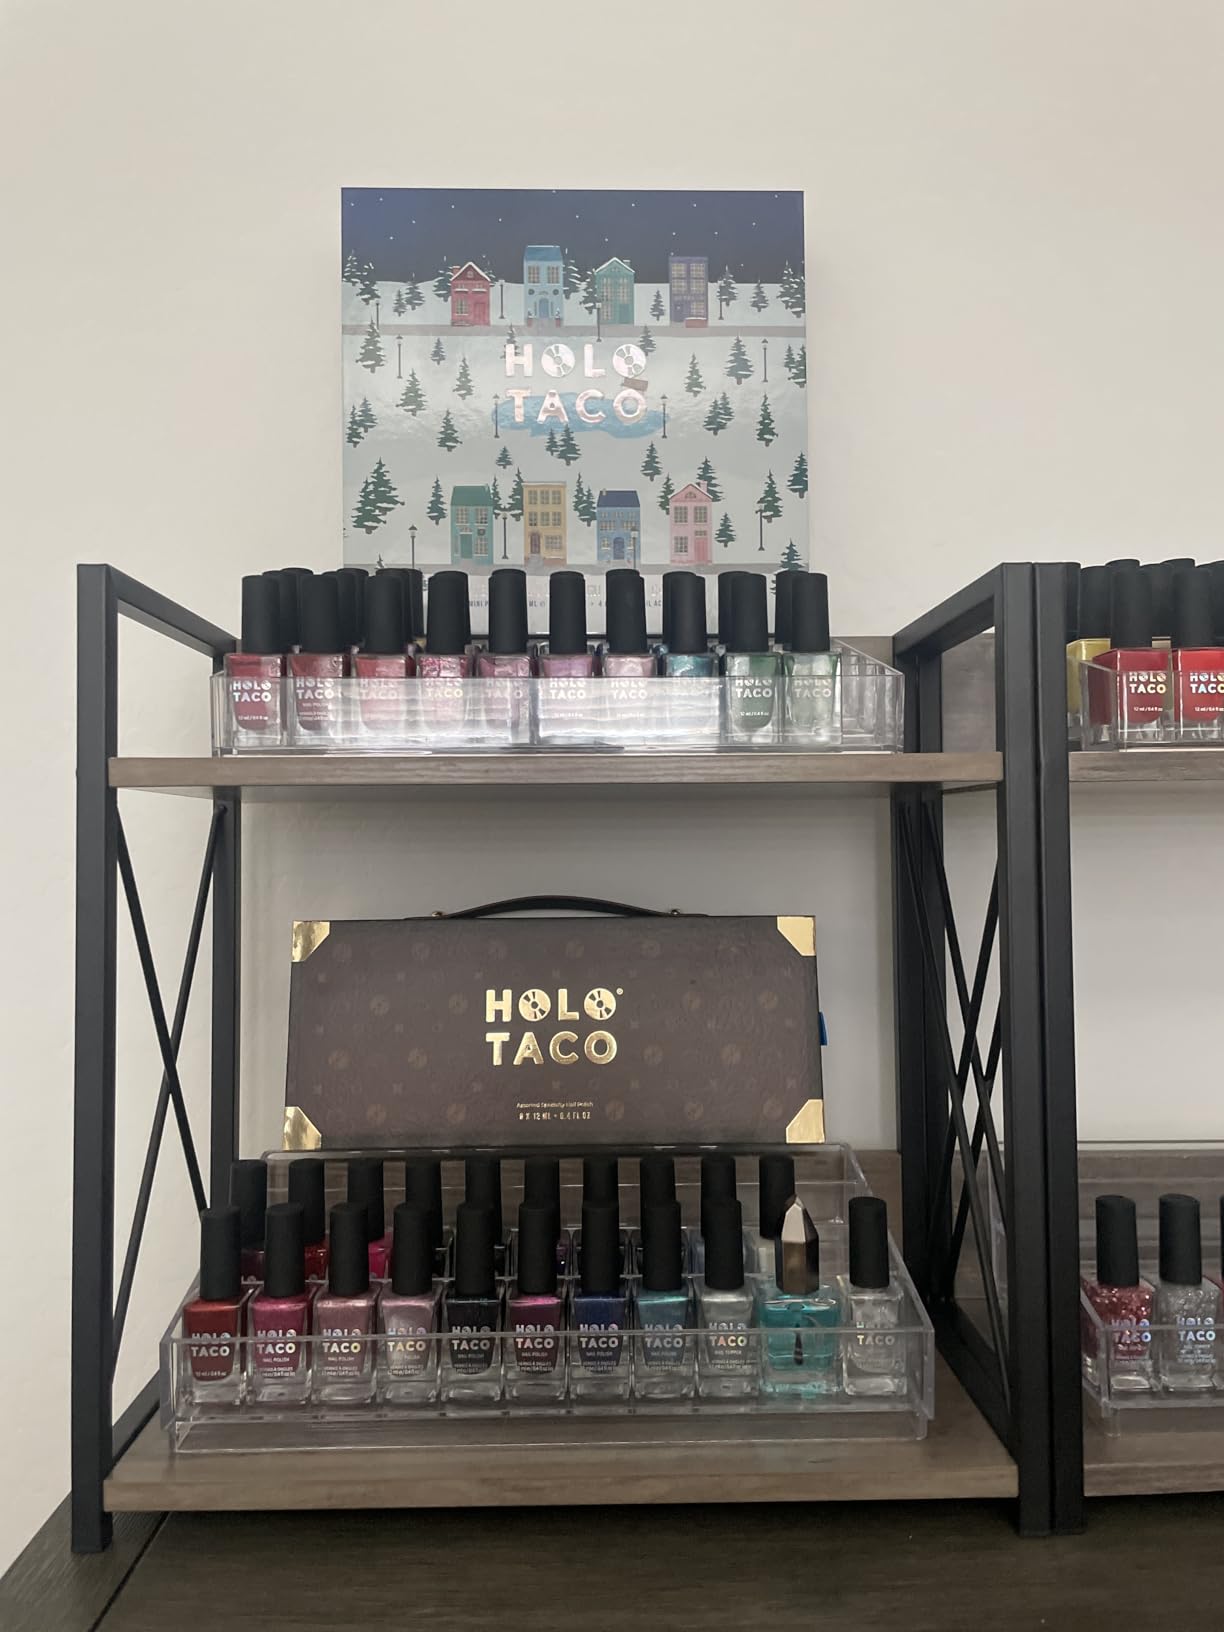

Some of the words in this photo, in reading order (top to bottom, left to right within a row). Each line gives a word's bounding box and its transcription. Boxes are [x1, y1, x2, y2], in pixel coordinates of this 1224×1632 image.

[505, 343, 647, 378] HOLO
[505, 388, 648, 423] TACO
[1129, 671, 1167, 682] HOLO
[1189, 672, 1224, 682] HOLO
[232, 680, 272, 691] HOLO
[295, 677, 335, 688] HOLO
[295, 689, 335, 699] TACO
[359, 689, 398, 699] TACO
[549, 689, 587, 699] TACO
[612, 689, 648, 699] TACO
[735, 688, 773, 698] TACO
[794, 688, 832, 698] TACO
[1129, 683, 1167, 694] TACO
[1189, 683, 1224, 694] TACO
[232, 692, 272, 702] TACO
[485, 987, 617, 1022] HOLO
[485, 1030, 618, 1066] TACO
[533, 1112, 541, 1120] 12
[709, 1335, 747, 1347] TACO
[856, 1334, 896, 1346] TACO
[1178, 1330, 1216, 1341] TACO
[256, 1342, 296, 1354] TACO
[322, 1342, 361, 1354] TACO
[387, 1341, 426, 1352] TACO
[452, 1339, 490, 1351] TACO
[515, 1338, 554, 1349] TACO
[579, 1337, 619, 1348] TACO
[645, 1337, 683, 1348] TACO
[191, 1346, 230, 1357] TACO
